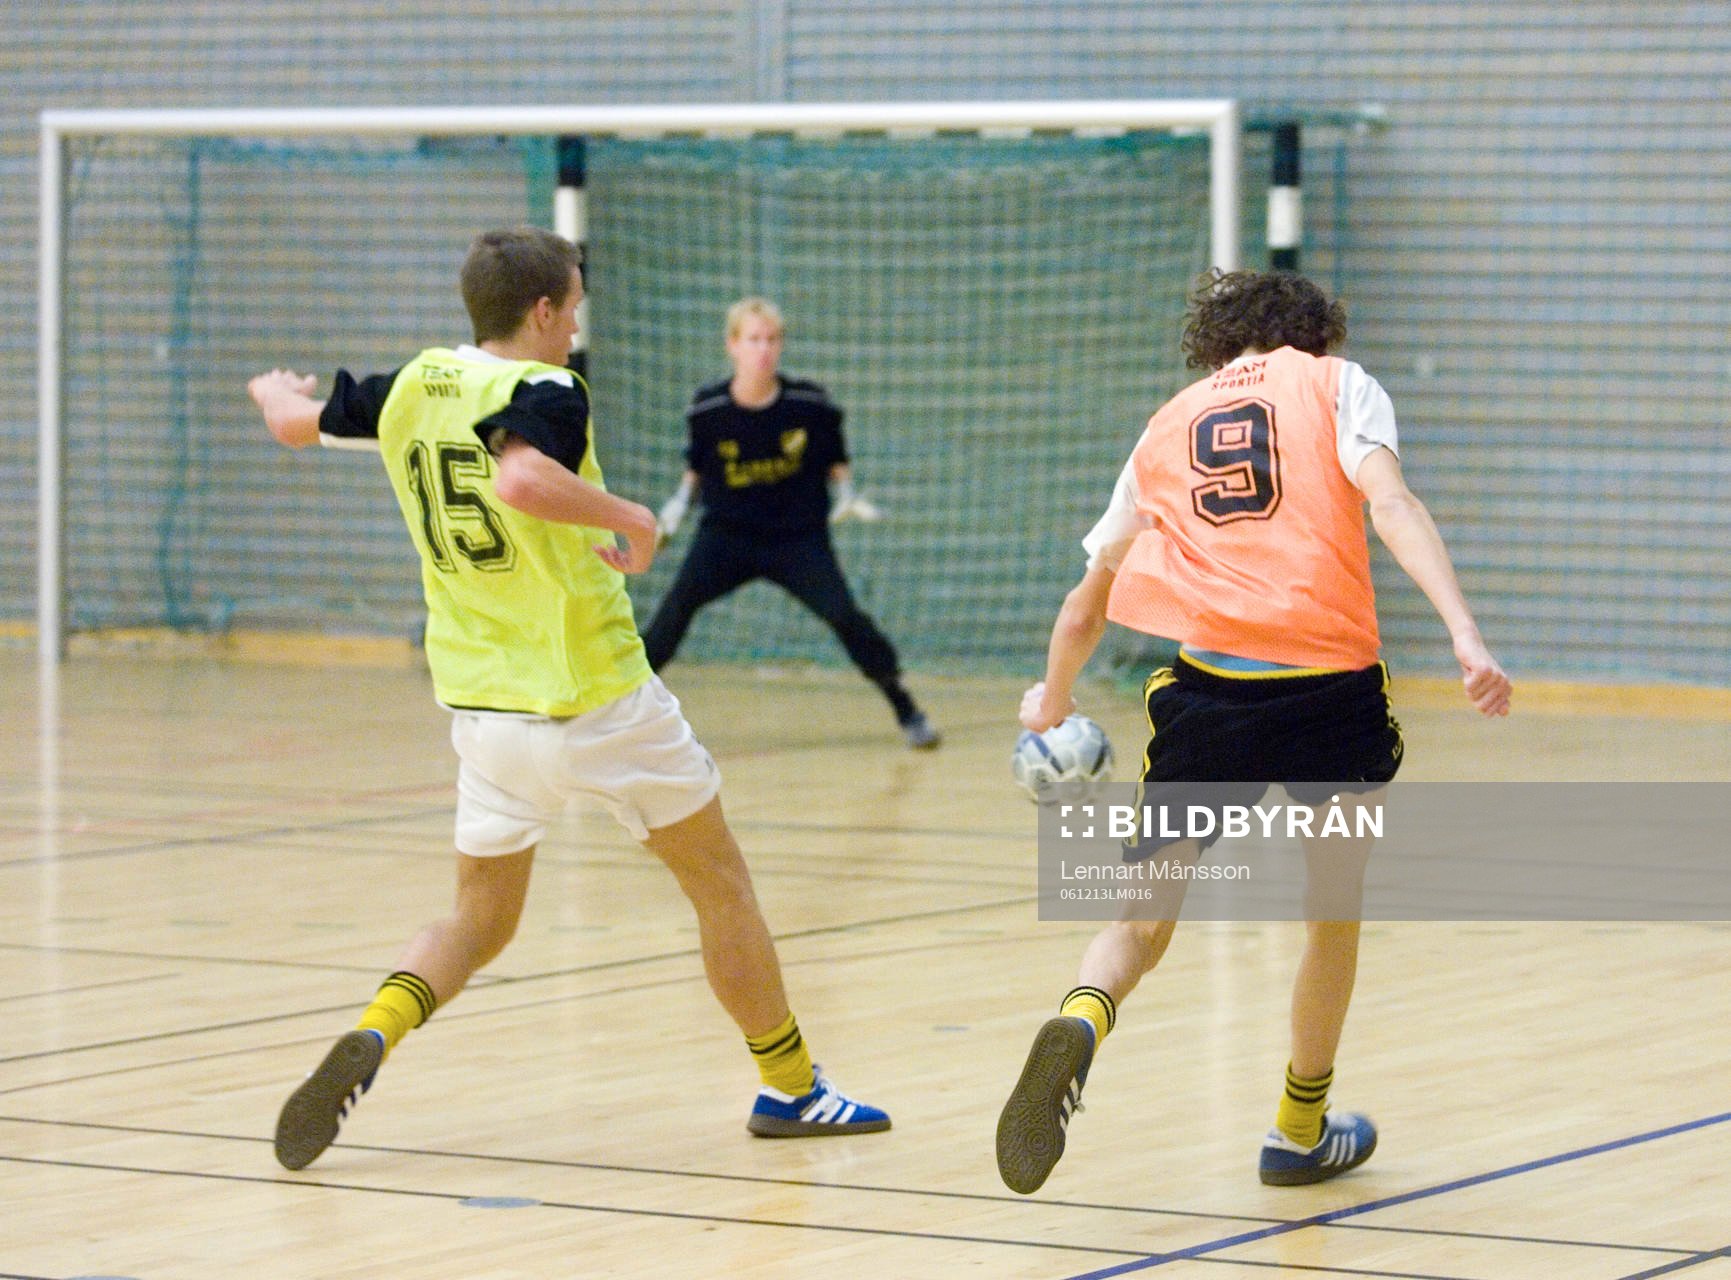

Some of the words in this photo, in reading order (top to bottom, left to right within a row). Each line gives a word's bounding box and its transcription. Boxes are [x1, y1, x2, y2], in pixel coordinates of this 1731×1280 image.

[1210, 373, 1265, 391] SPORTIA
[404, 440, 518, 573] 15
[1189, 396, 1283, 528] 9
